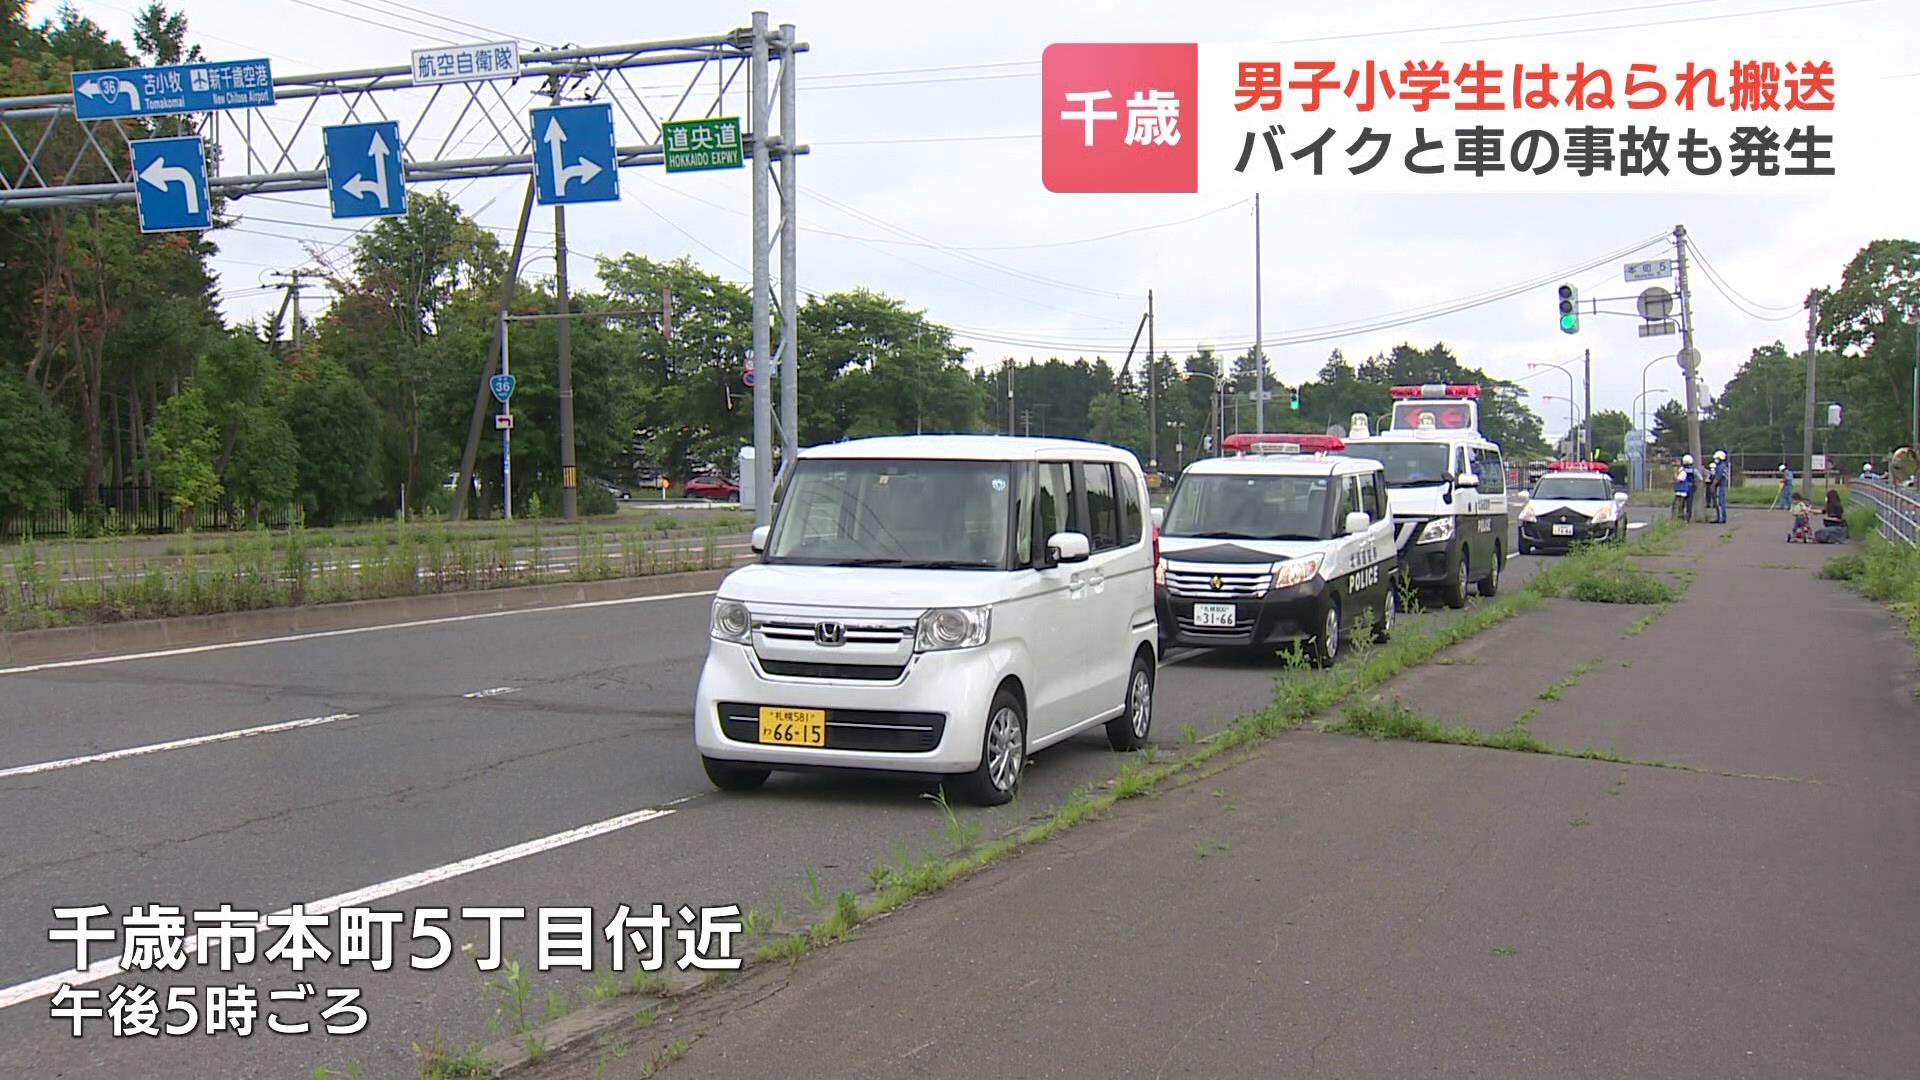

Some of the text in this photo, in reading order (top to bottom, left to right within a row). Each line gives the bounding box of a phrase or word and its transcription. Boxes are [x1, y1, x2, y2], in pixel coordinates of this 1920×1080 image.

[418, 46, 512, 78] 航空自衛隊
[143, 71, 183, 95] 苫小牧
[209, 65, 269, 90] 新千歳空港
[102, 82, 116, 95] 36
[248, 90, 269, 104] Airport
[144, 96, 185, 110] Tomakomai
[667, 123, 738, 152] 道央道
[670, 150, 738, 168] HOKKAIDO EXPWY
[495, 381, 511, 392] 36
[1348, 565, 1379, 594] POLICE
[1203, 612, 1233, 625] 31-66
[774, 723, 821, 743] 66-15
